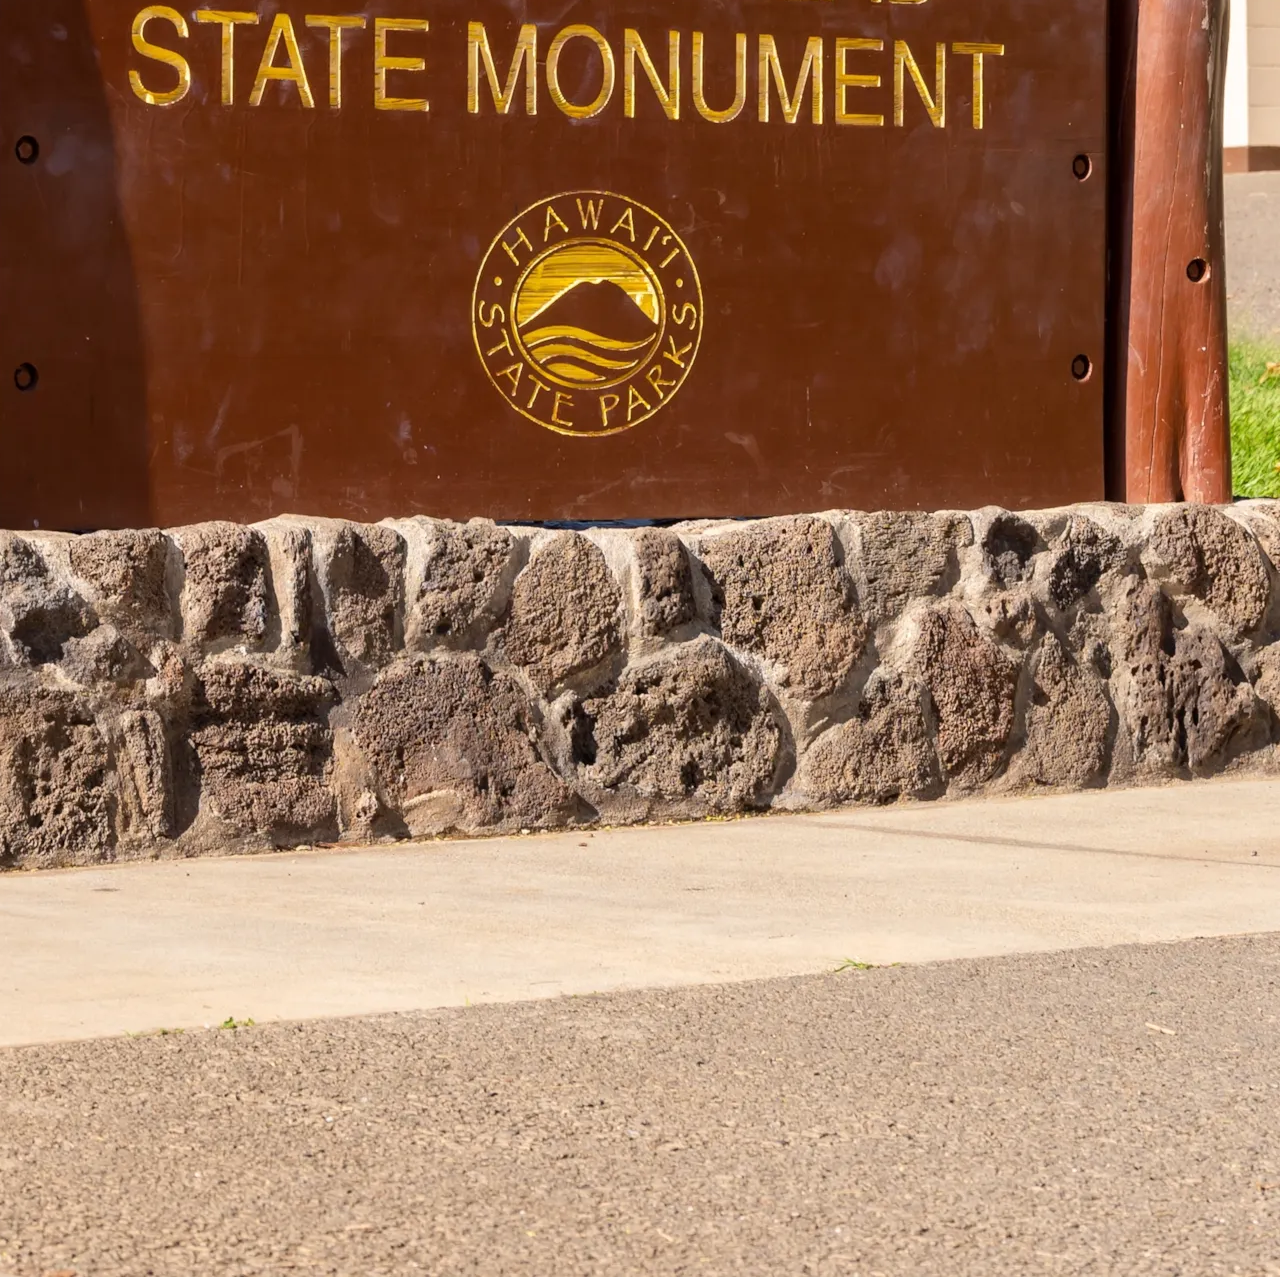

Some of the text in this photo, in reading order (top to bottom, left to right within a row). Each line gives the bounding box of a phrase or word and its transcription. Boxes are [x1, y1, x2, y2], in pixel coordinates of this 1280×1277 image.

[128, 4, 1006, 130] STATE MONUMENT
[478, 299, 698, 427] STATE PARKS
